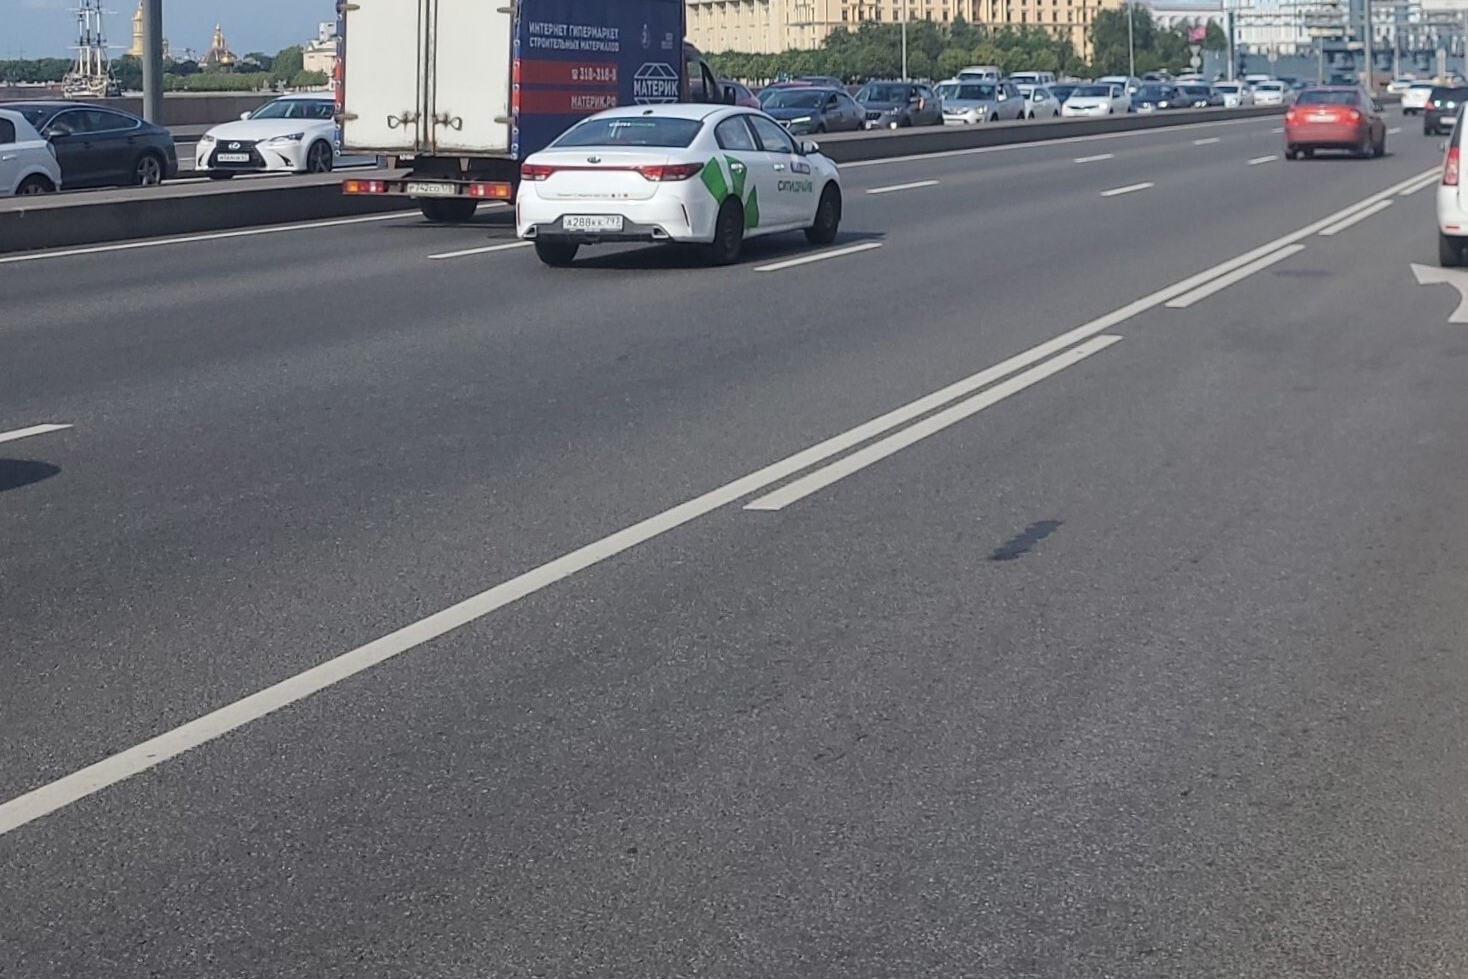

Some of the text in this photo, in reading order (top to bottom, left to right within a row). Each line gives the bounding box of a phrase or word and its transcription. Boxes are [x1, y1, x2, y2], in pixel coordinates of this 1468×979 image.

[529, 22, 619, 39] ИНТЕРНЕТ ГИПЕРМАРКЕТ
[529, 37, 620, 52] СТРОИТЕЛЬНЫХ МАТЕРИАЛОВ
[633, 80, 679, 96] МАТЕРИК
